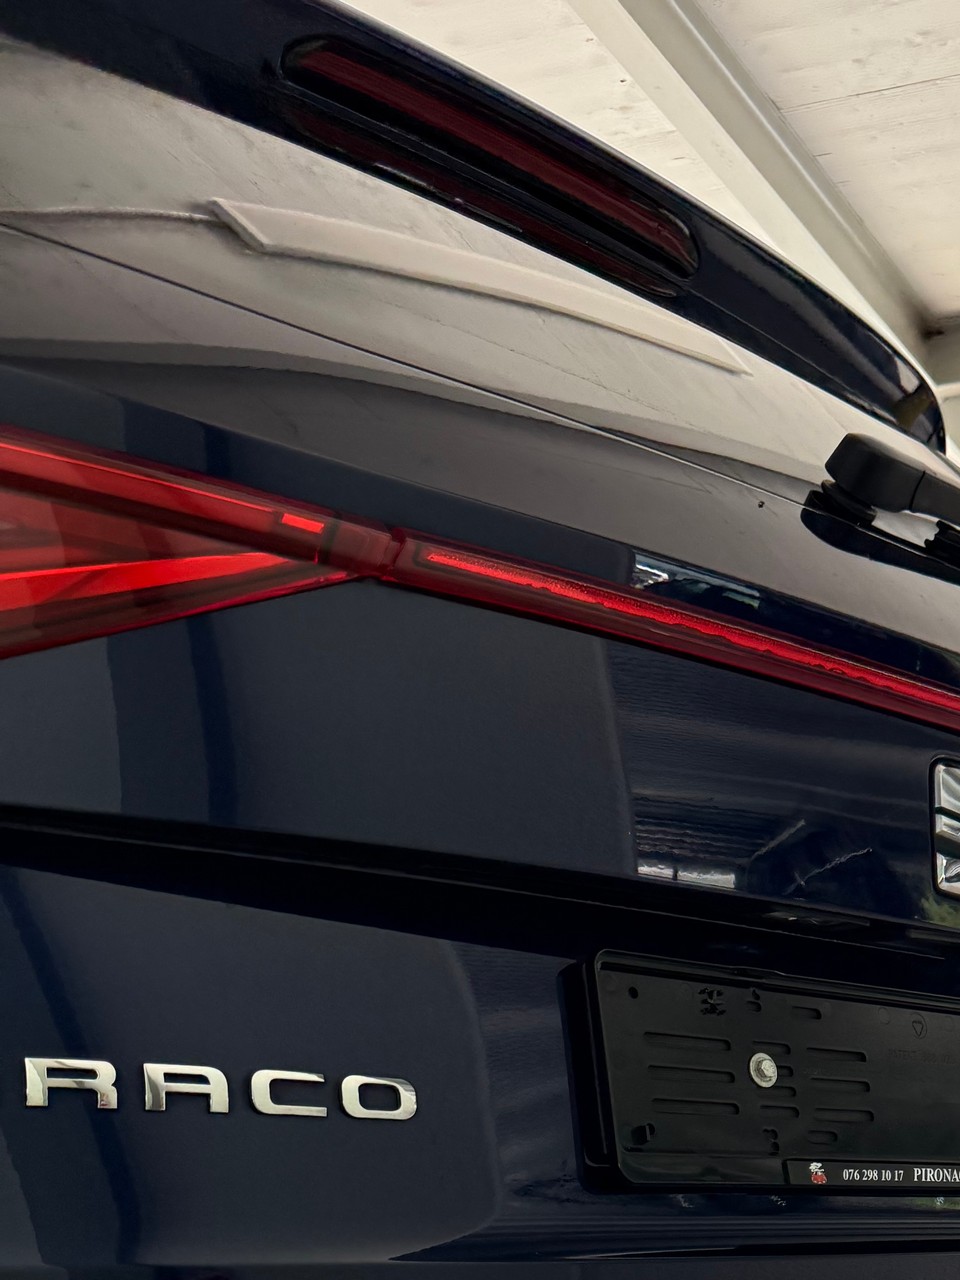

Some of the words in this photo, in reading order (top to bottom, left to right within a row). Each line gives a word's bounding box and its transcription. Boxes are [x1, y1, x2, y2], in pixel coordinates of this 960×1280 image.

[25, 1057, 419, 1120] RACO
[842, 1168, 861, 1181] 076
[861, 1169, 879, 1182] 298
[881, 1170, 892, 1183] 10
[894, 1170, 905, 1183] 17
